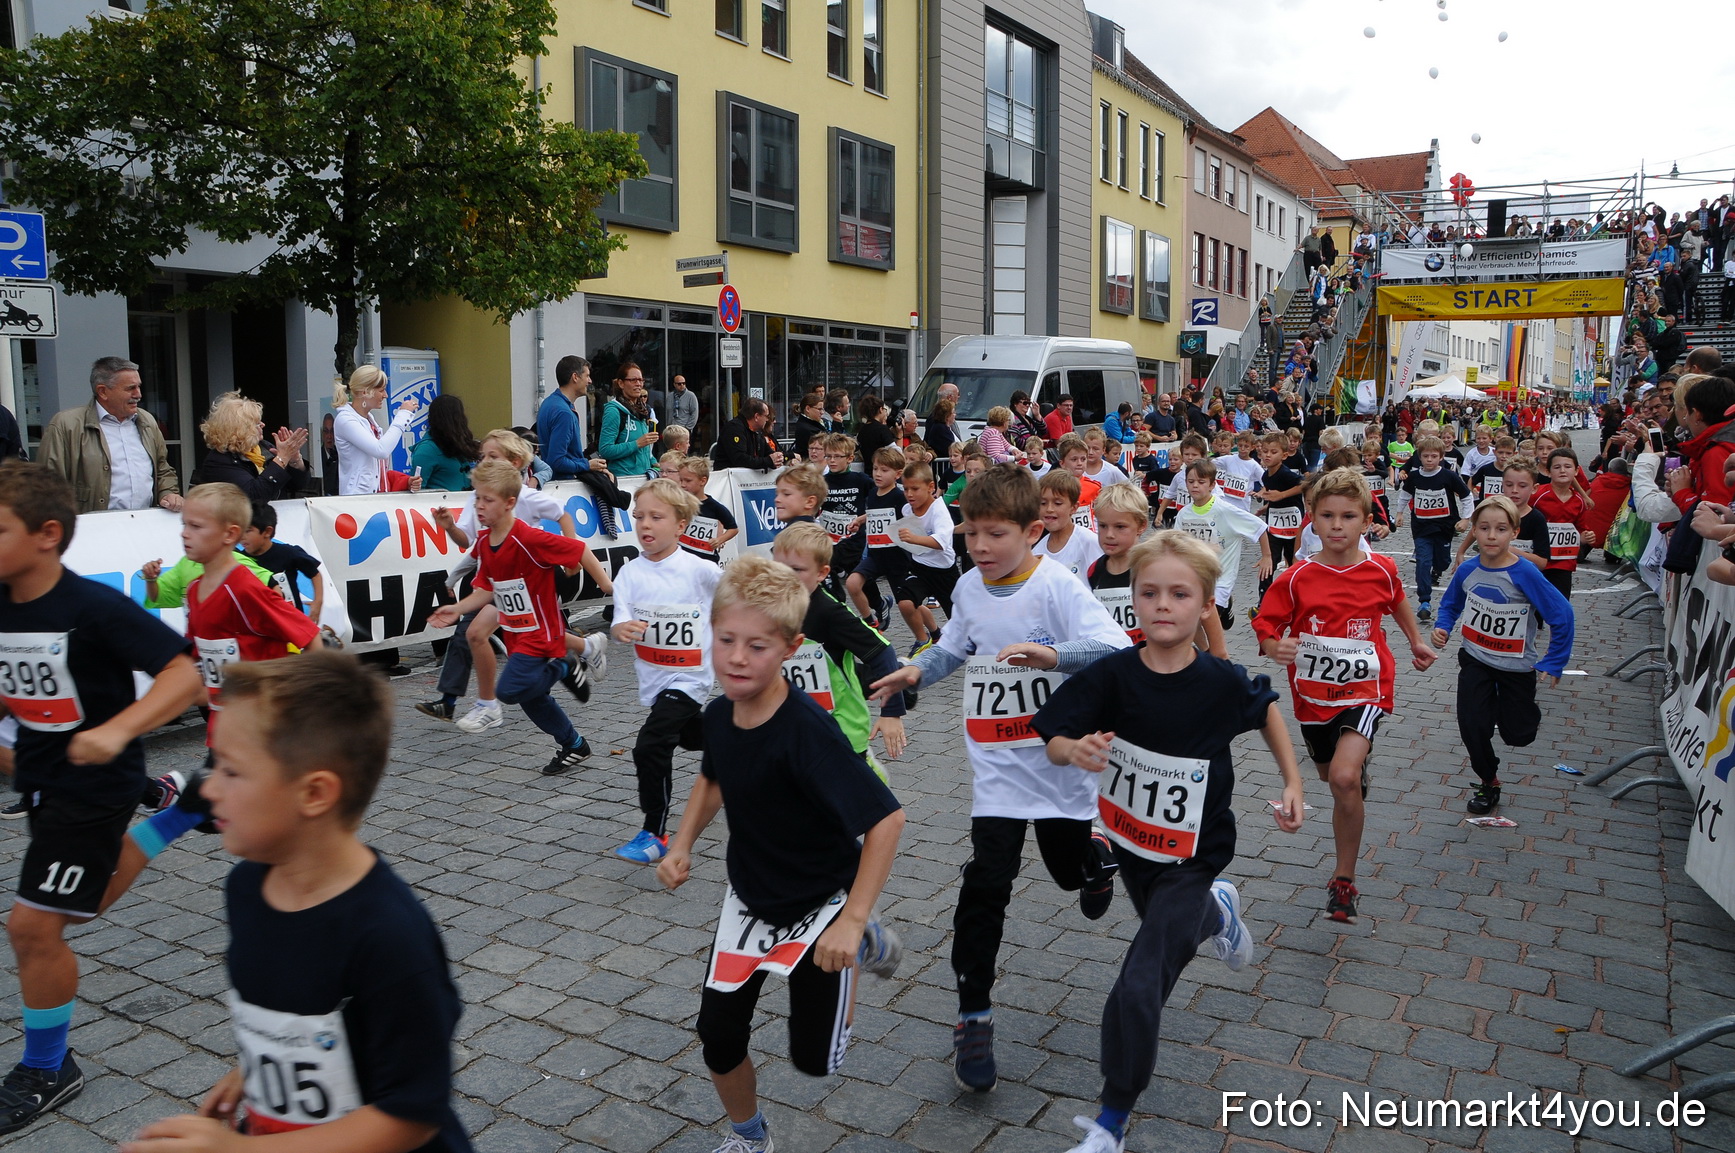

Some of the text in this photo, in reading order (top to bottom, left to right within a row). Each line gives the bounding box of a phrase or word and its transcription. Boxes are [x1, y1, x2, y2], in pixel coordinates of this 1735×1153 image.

[677, 258, 722, 269] Brunnwirtsgasse
[1480, 250, 1578, 261] EfficientDynamics
[0, 289, 25, 299] nur
[1453, 288, 1538, 309] START
[1400, 345, 1417, 388] Audi BKK
[827, 487, 860, 496] UMARKTER
[1226, 479, 1245, 490] 7106
[1417, 498, 1445, 509] 7323
[1273, 515, 1298, 527] 7119
[1549, 531, 1577, 545] 7096
[1467, 595, 1518, 615] PARTL Neumarkt
[653, 611, 690, 619] Neumarkt
[1107, 605, 1137, 629] 46
[1470, 606, 1521, 636] 7087
[1322, 645, 1361, 655] Neumarkt
[1476, 634, 1506, 650] Moritz
[653, 651, 677, 664] Luca
[966, 665, 990, 675] PARTL
[1303, 654, 1369, 683] 7228
[971, 677, 1051, 716] 7210
[1327, 687, 1346, 699] tim
[996, 721, 1034, 738] Felix
[1129, 757, 1186, 780] Neumarkt
[1108, 759, 1189, 824] 7113
[1113, 810, 1165, 849] Vincent
[38, 861, 85, 895] 10
[735, 908, 820, 954] 738
